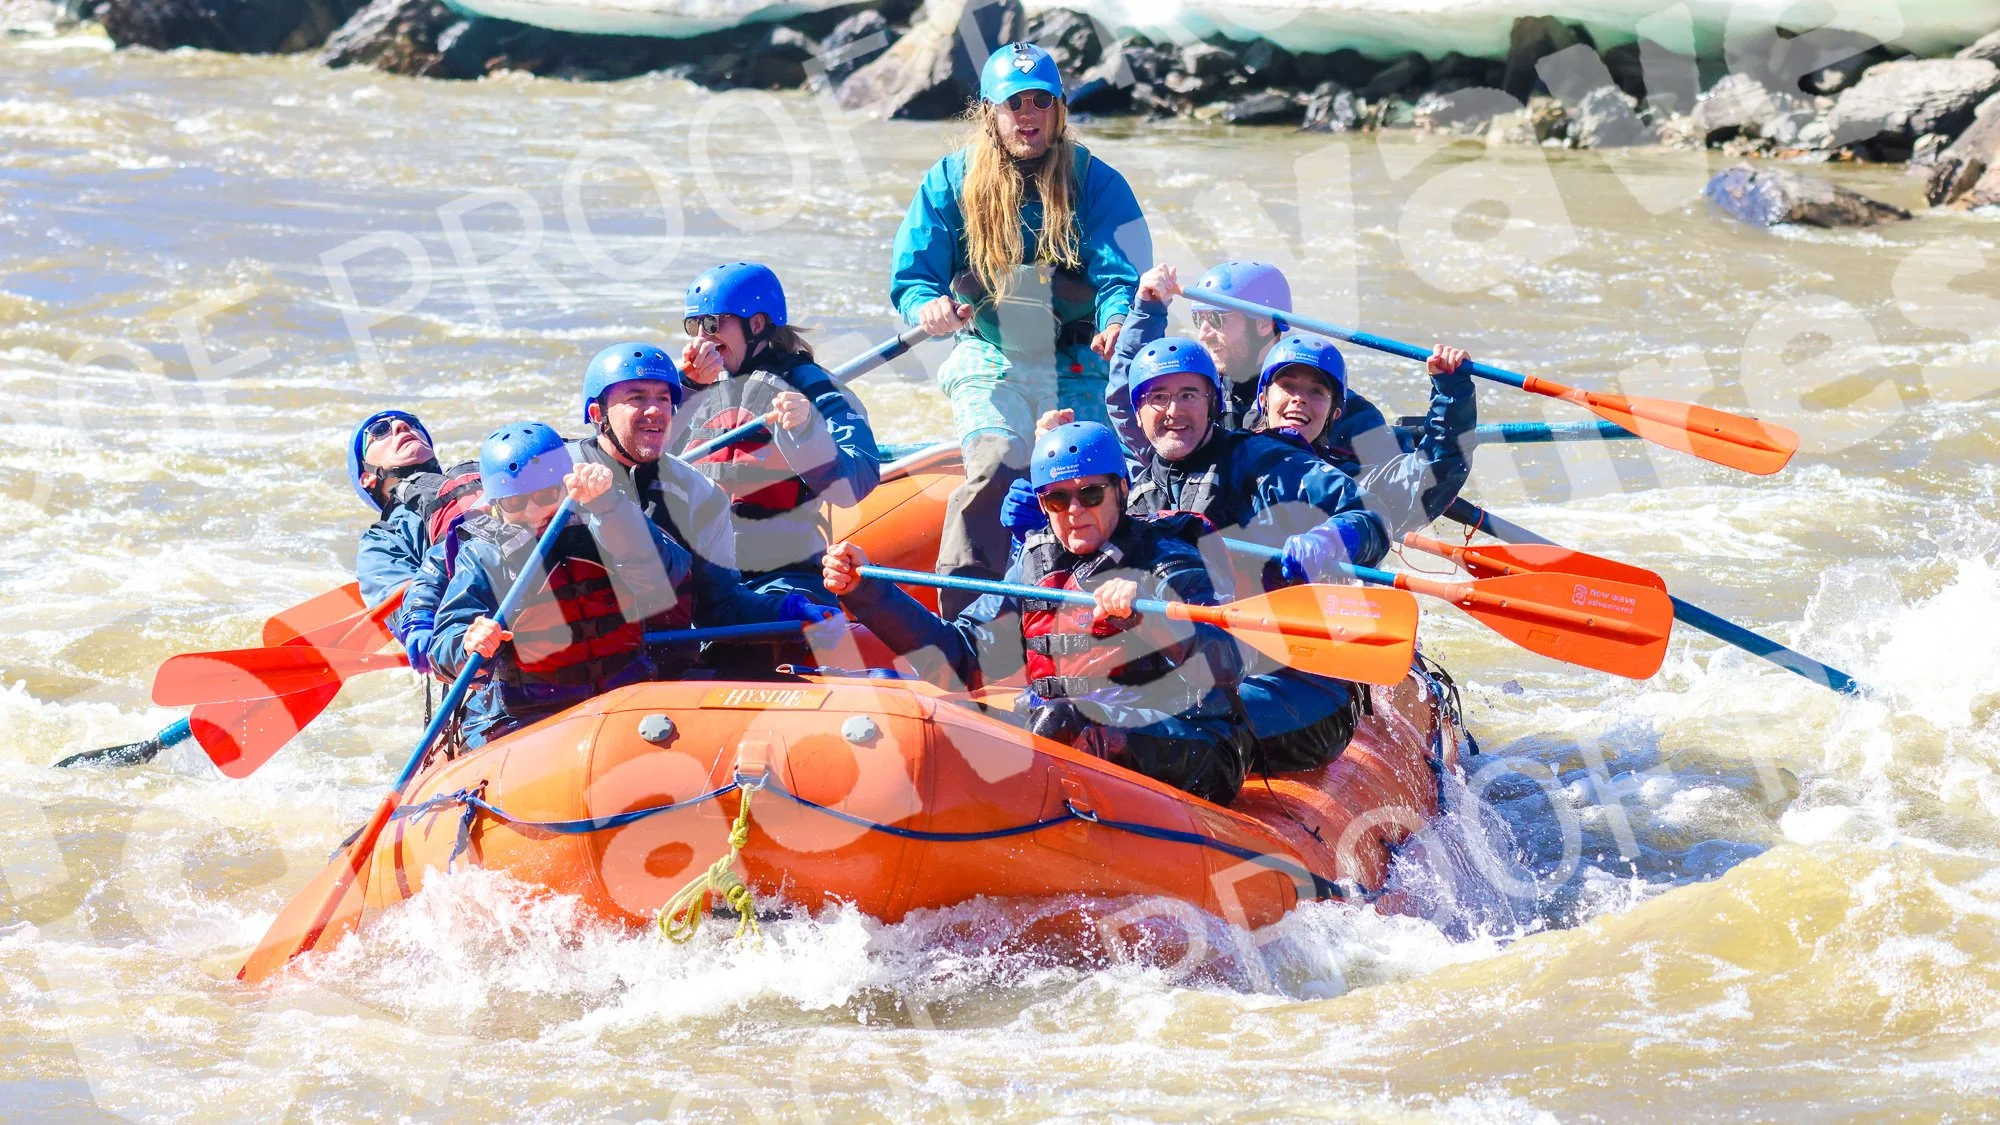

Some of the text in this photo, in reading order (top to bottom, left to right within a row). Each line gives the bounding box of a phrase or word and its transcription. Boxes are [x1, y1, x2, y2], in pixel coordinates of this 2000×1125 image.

[1589, 589, 1637, 606] new wave
[722, 688, 808, 707] HYSIDE
